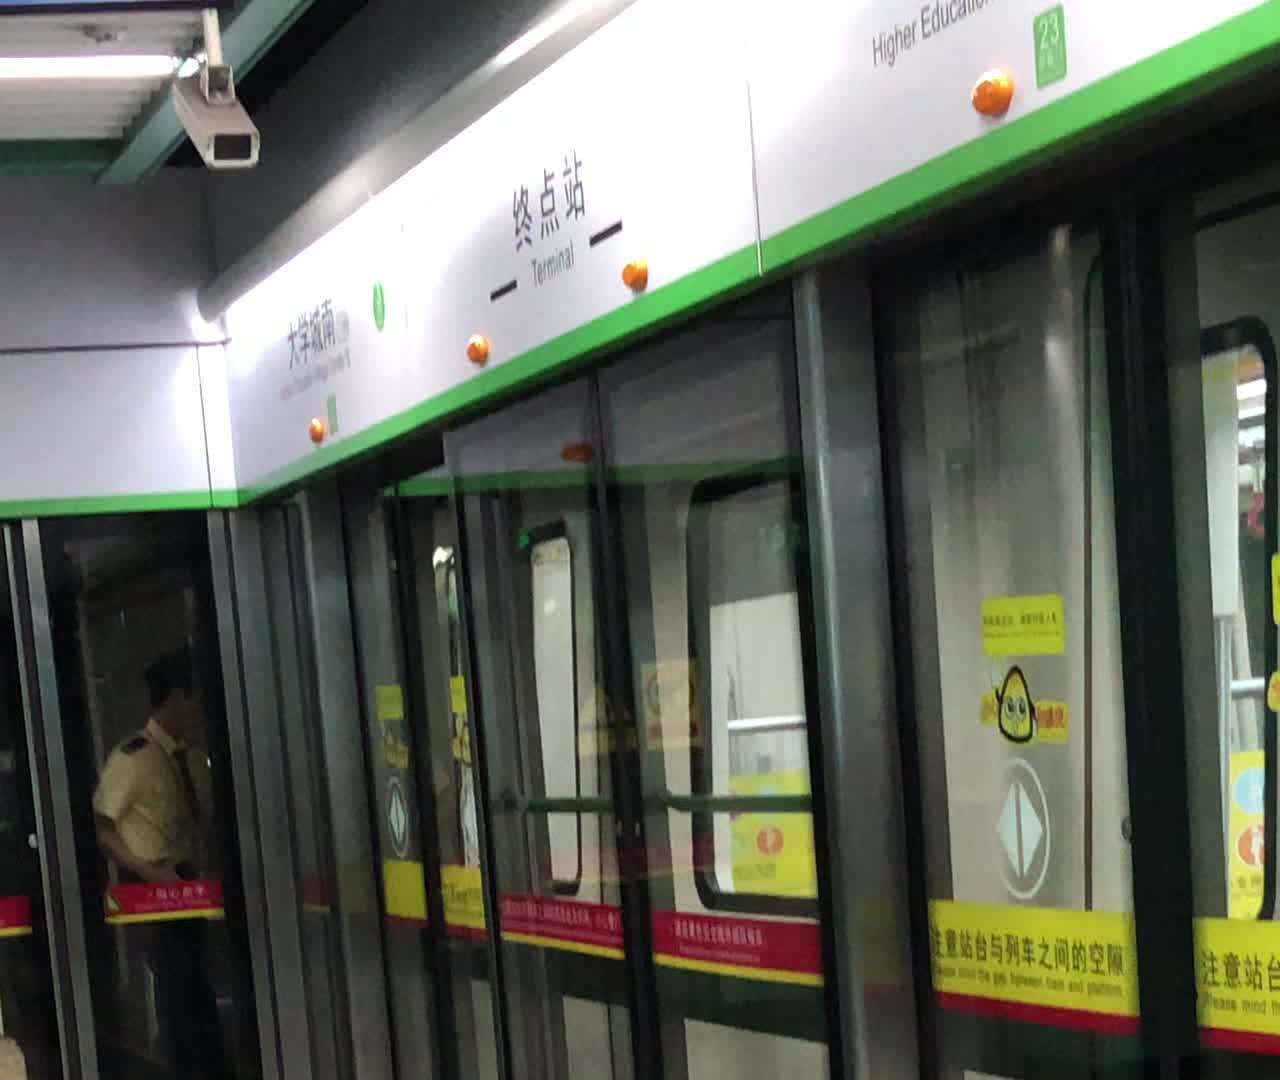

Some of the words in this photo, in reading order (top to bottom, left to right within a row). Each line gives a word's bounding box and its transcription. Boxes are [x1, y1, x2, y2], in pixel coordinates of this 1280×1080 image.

[872, 20, 917, 68] Higher
[921, 0, 994, 40] Educati
[1039, 13, 1061, 50] 23
[512, 149, 585, 252] 终点站
[531, 238, 575, 288] Terminal
[931, 924, 1124, 976] 注意站台与列车之间的空隙
[1241, 998, 1267, 1014] mind
